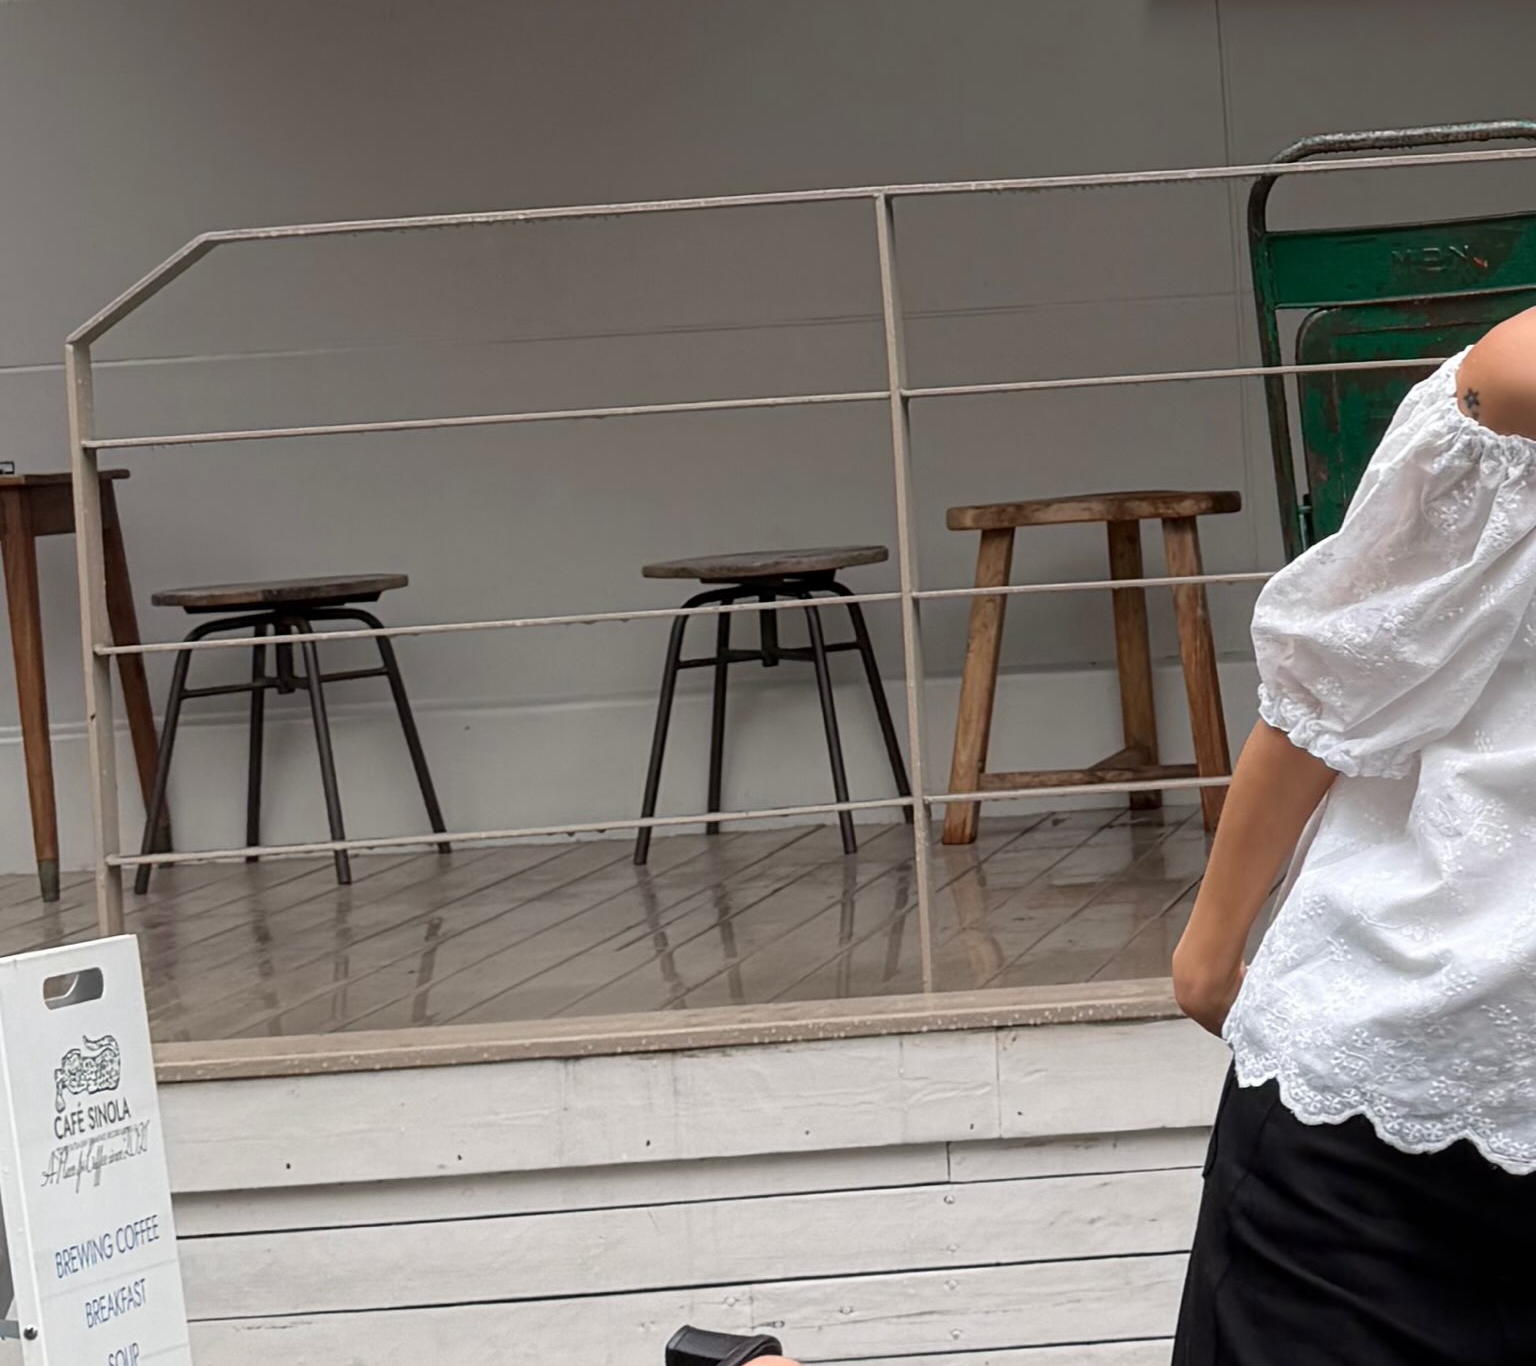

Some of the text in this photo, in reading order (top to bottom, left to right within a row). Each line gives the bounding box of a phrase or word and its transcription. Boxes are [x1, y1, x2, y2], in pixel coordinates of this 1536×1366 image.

[54, 1101, 85, 1140] CAFÉ
[87, 1096, 132, 1130] SINOLA
[55, 1214, 160, 1279] BREWING COFFEE
[85, 1277, 147, 1329] BREAKFAST
